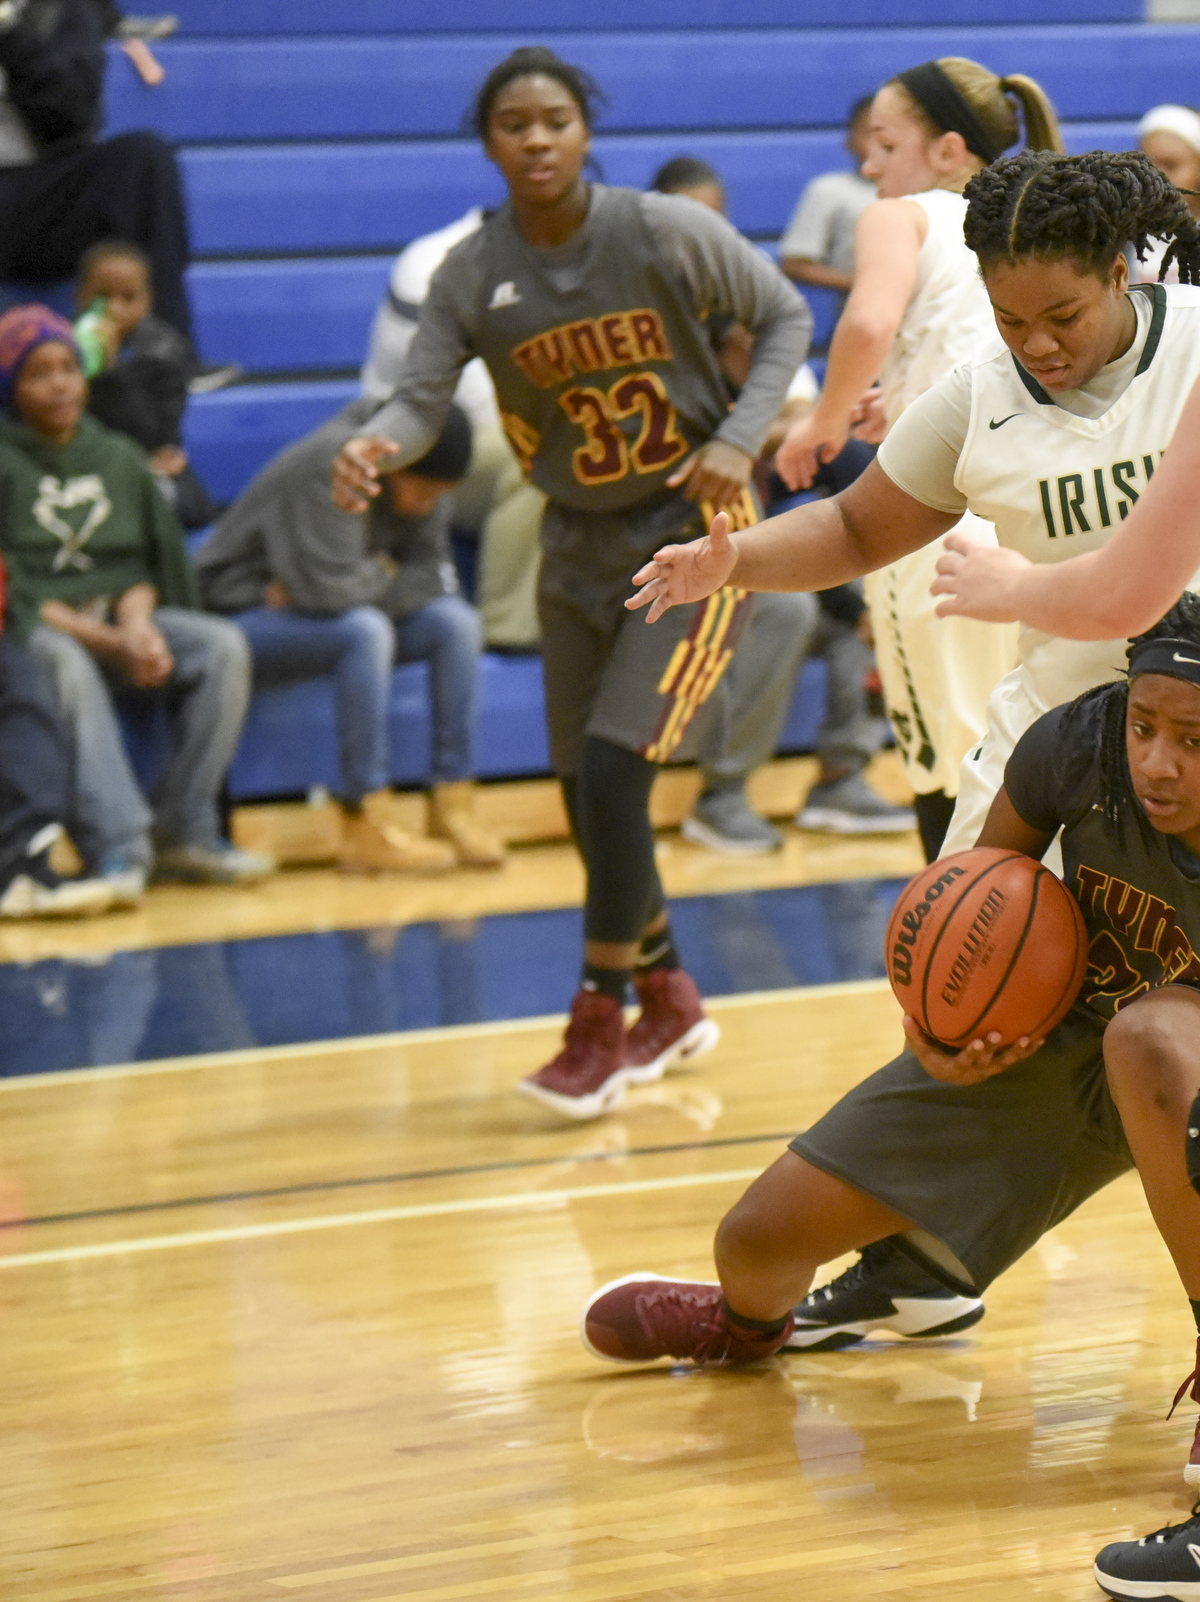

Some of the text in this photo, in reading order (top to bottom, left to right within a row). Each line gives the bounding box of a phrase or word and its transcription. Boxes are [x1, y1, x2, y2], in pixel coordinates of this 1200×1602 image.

[511, 307, 674, 389] TYNER
[558, 371, 690, 485] 32
[940, 886, 1005, 1008] EVOLUTION
